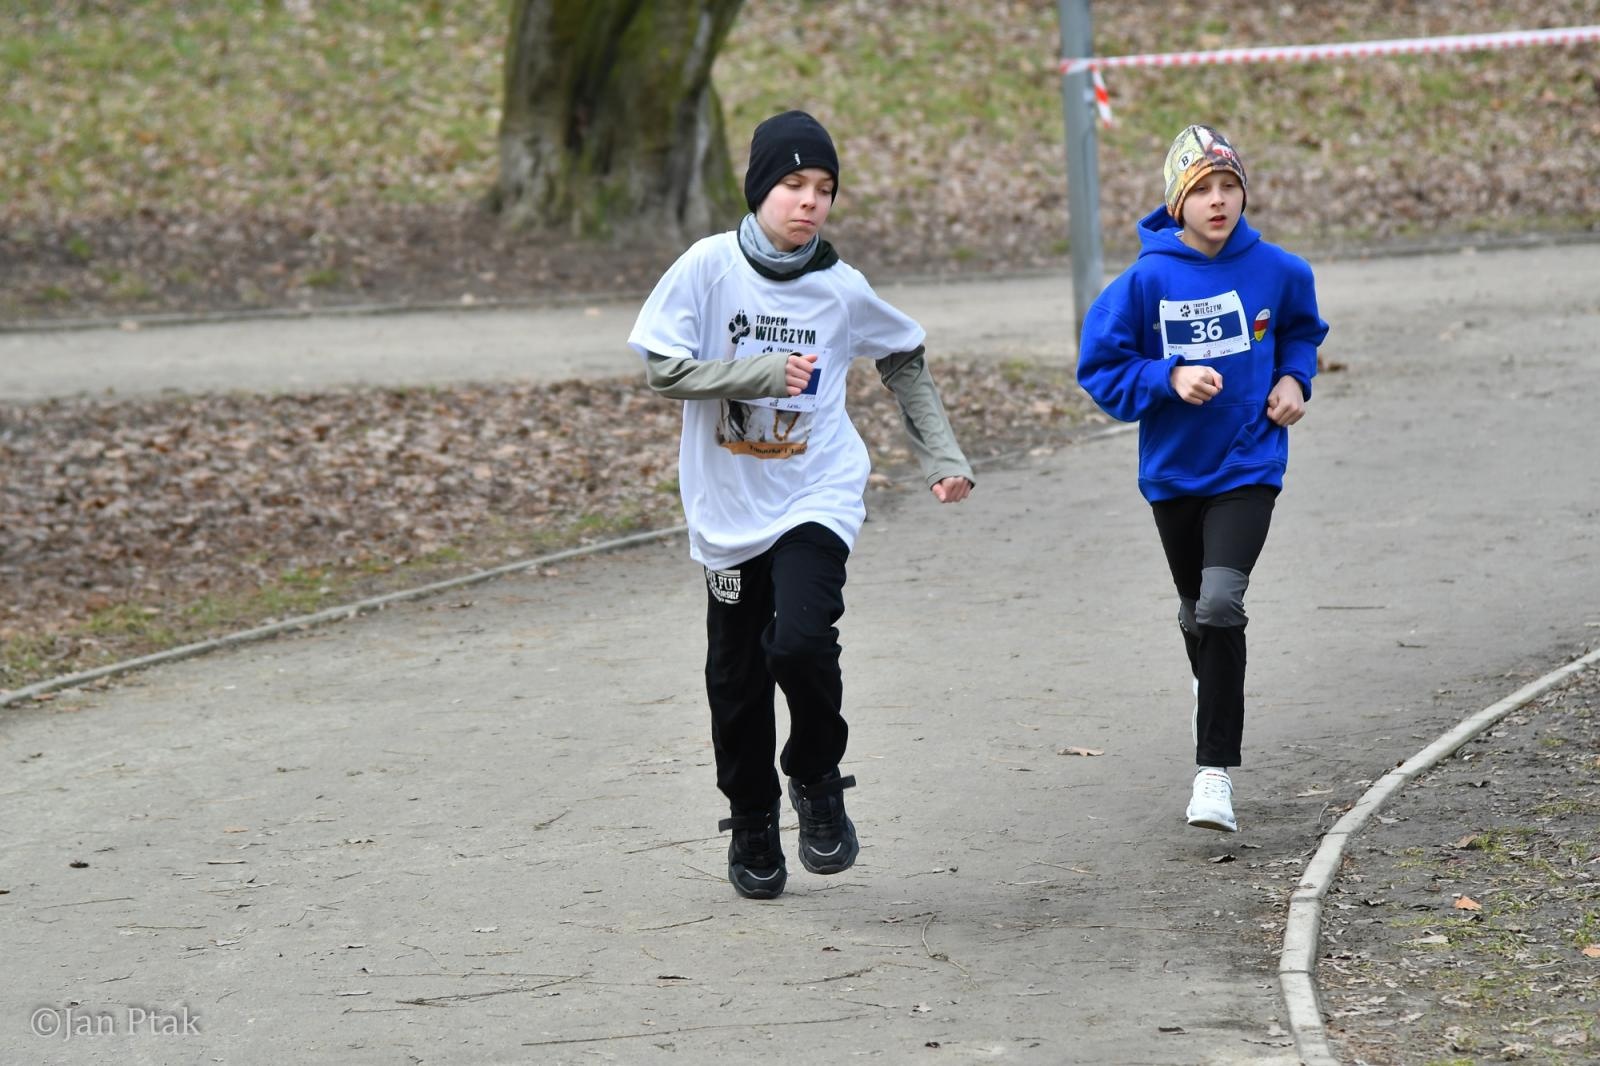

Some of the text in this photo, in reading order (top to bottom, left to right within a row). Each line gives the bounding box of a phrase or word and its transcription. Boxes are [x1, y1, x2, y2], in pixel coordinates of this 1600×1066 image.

[1181, 156, 1189, 167] B
[1194, 303, 1223, 315] WILCZYM
[756, 314, 788, 327] TROPEM
[755, 326, 816, 345] WILCZYM
[1190, 317, 1223, 343] 36
[718, 576, 741, 591] FUN
